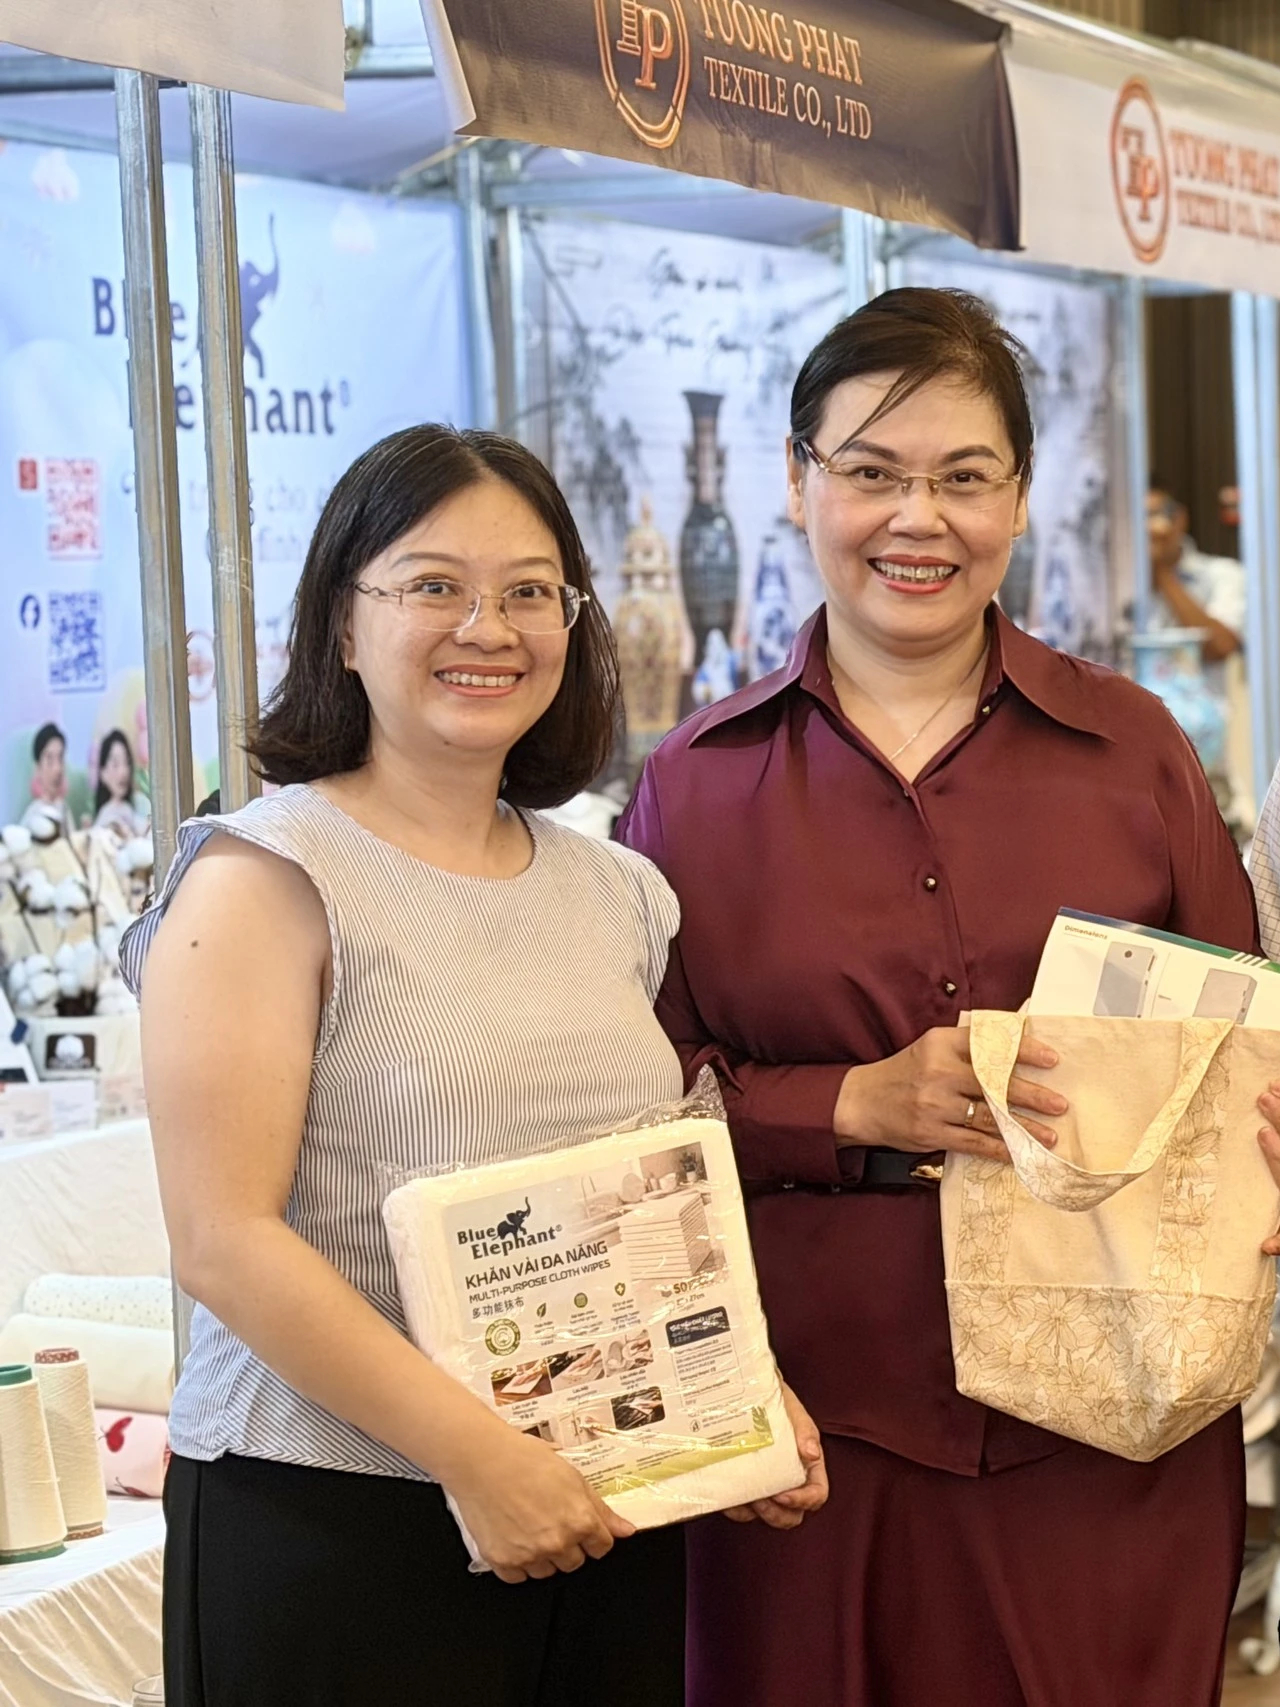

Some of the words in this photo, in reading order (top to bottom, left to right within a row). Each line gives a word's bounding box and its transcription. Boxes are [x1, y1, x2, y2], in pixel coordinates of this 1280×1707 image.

[794, 19, 863, 86] PHAT
[704, 56, 788, 117] TEXTILE
[793, 82, 831, 138] CO.,
[836, 95, 872, 140] LTD
[457, 1227, 497, 1245] Blue
[465, 1264, 511, 1290] KHĂN
[513, 1256, 539, 1277] VẢI
[541, 1253, 564, 1270] ĐA
[566, 1240, 608, 1263] NĂNG
[469, 1275, 547, 1304] MULTI-PURPOSE
[549, 1267, 580, 1284] CLOTH
[581, 1258, 611, 1274] WIPES
